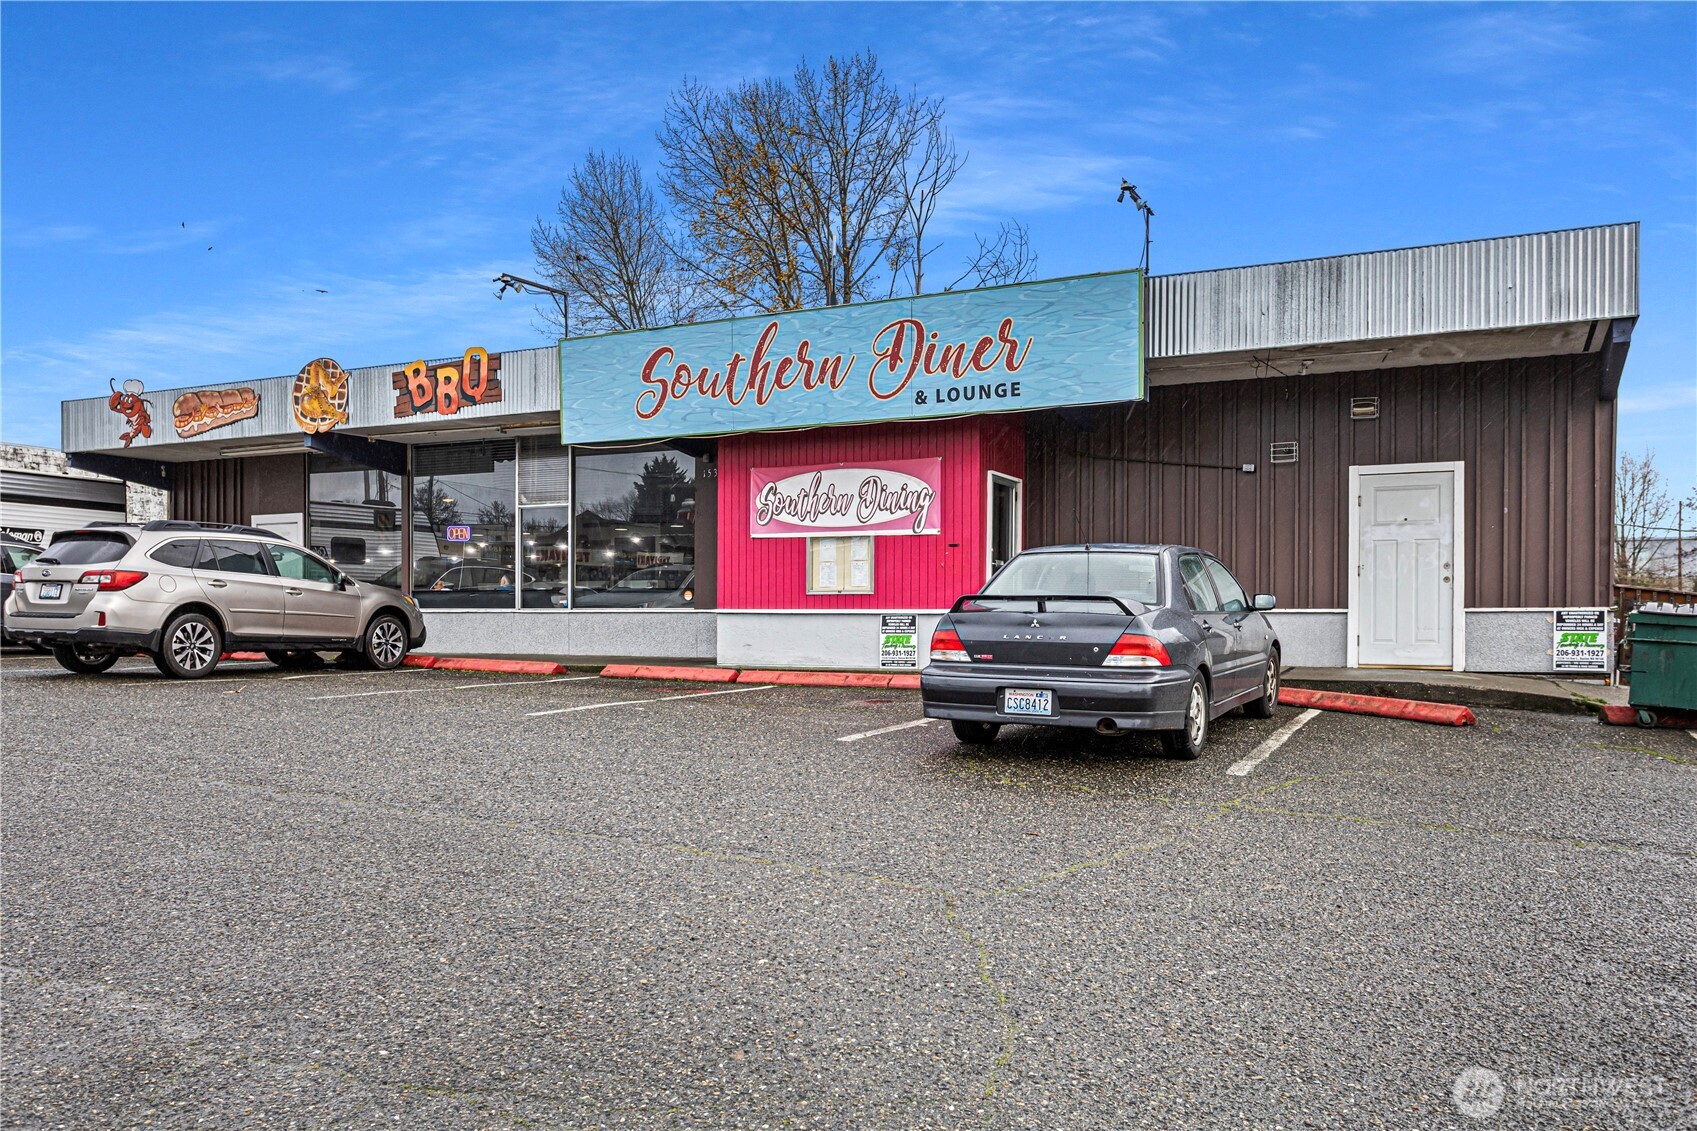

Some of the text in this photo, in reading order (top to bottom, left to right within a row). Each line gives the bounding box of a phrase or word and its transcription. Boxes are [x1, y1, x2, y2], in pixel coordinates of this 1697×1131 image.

[635, 317, 1033, 420] Southern Diner
[404, 347, 488, 415] BBQ
[914, 381, 1021, 405] & LOUNGE
[756, 471, 936, 533] Southern Dining
[448, 527, 469, 540] OPEN
[884, 635, 912, 644] STATE
[1560, 632, 1599, 643] STATE
[1007, 697, 1049, 711] CSC8412
